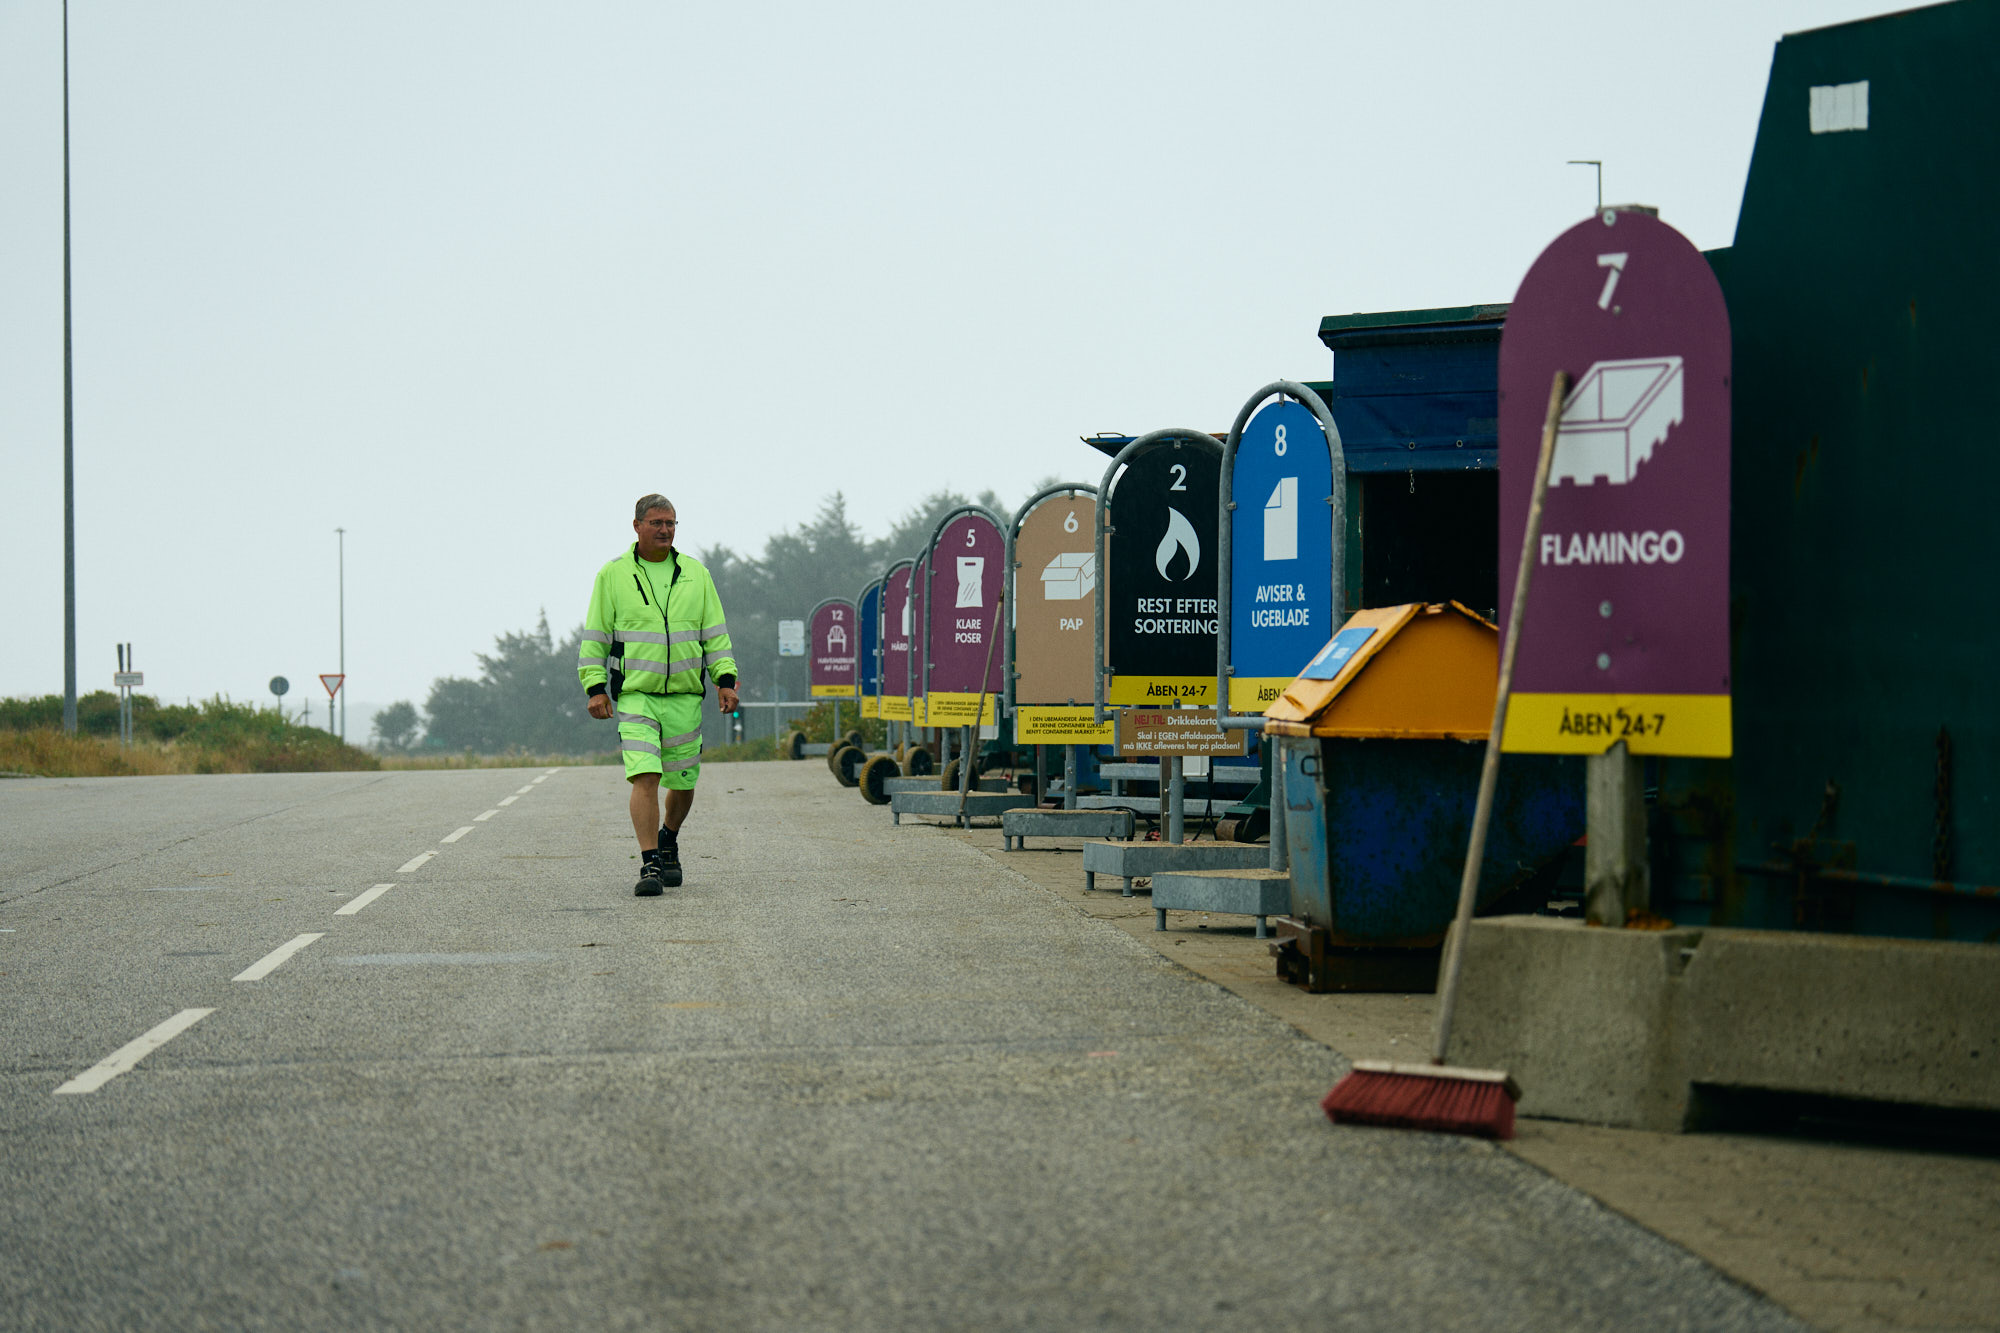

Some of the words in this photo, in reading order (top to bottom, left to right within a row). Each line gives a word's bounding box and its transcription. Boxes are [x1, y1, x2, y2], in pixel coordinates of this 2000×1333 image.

[1597, 253, 1628, 310] 7
[1274, 424, 1287, 456] 8
[1170, 464, 1187, 491] 2
[1063, 511, 1079, 533] 6
[965, 528, 976, 547] 5
[1541, 531, 1684, 565] FLAMINGO
[1255, 584, 1293, 603] AVISER
[1296, 584, 1306, 601] &
[1137, 598, 1172, 613] REST
[1176, 598, 1219, 614] EFTER
[831, 609, 844, 621] 12
[1251, 608, 1310, 628] UGEBLADE
[956, 618, 981, 630] KLARE
[1059, 618, 1083, 631] PAP
[1134, 618, 1219, 634] SORTERING
[955, 632, 981, 644] POSER
[1146, 682, 1178, 696] ÅBEN
[1181, 685, 1207, 696] 24-7
[1257, 684, 1281, 701] ÅBEN
[1134, 715, 1150, 725] NEJ
[1167, 716, 1218, 726] Drikkekarto
[1559, 706, 1612, 735] ÅBEN
[1618, 713, 1665, 736] 24-7
[1137, 731, 1152, 740] Skal
[1154, 732, 1157, 740] i
[1158, 732, 1178, 740] EGEN
[1180, 731, 1227, 742] affaldsspand,
[1123, 741, 1135, 750] må
[1136, 741, 1153, 750] IKKE
[1154, 741, 1185, 750] afleveres
[1186, 741, 1198, 750] her
[1200, 741, 1210, 752] på
[1211, 741, 1240, 752] pladsen!
